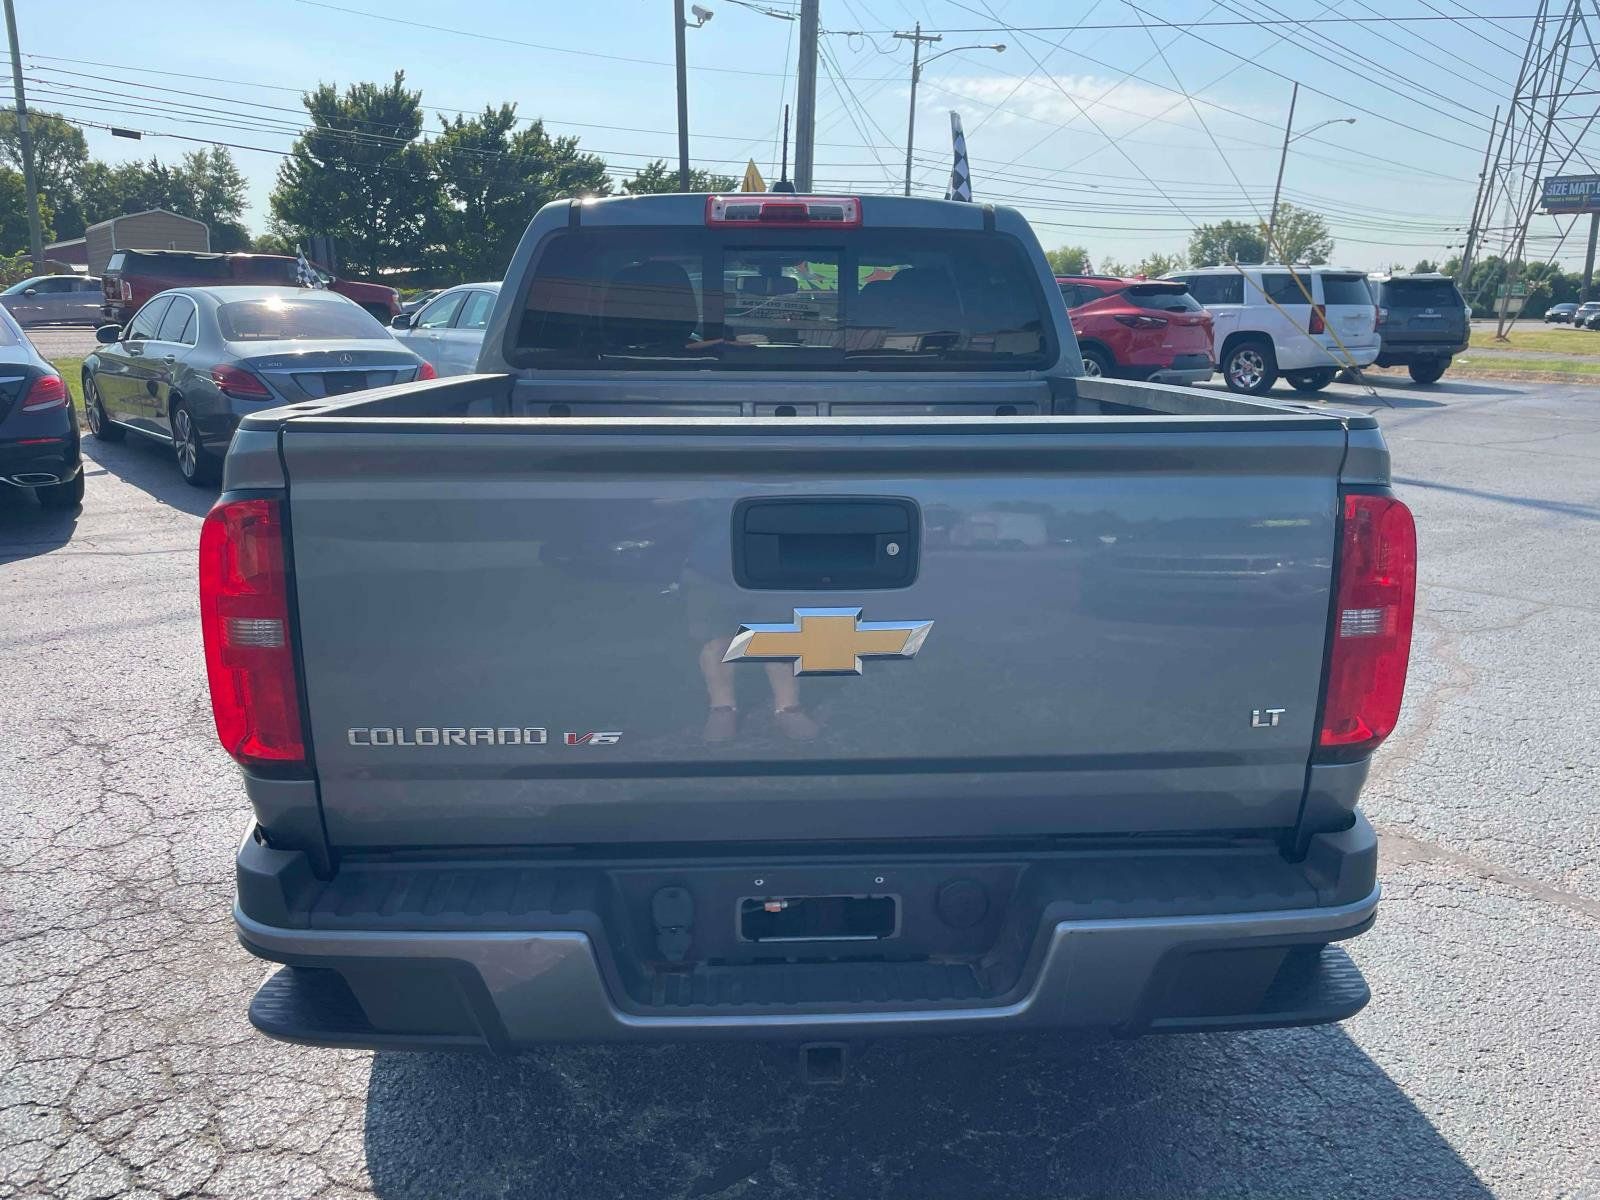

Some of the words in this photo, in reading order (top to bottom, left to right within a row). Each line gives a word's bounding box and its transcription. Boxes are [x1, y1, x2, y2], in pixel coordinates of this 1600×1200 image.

[1545, 183, 1569, 196] SIZE
[1252, 707, 1286, 728] LT
[348, 726, 547, 746] COLORADO
[563, 730, 623, 746] V6
